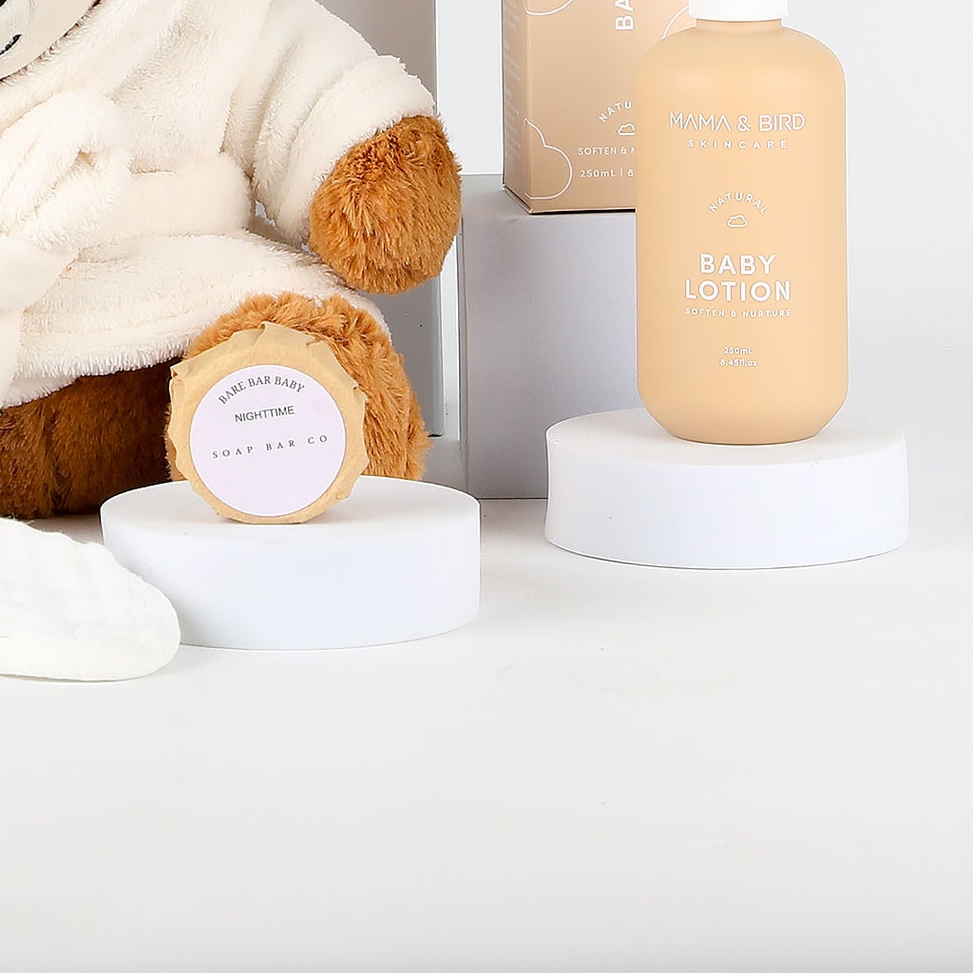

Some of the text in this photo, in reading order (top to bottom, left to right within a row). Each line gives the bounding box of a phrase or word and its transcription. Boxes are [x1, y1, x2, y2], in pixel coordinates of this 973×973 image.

[598, 100, 633, 123] NATU
[669, 112, 806, 132] MAMA & BIRD
[578, 146, 617, 156] SOFTEN
[620, 147, 628, 155] &
[687, 139, 788, 149] SKINCARE
[580, 169, 616, 178] 250mL
[708, 192, 770, 215] NATURAL
[699, 253, 777, 276] BABY
[685, 279, 792, 302] LOTION
[684, 307, 726, 318] SOFTEN
[742, 309, 792, 318] NURTURE
[723, 346, 754, 355] 250mL
[218, 375, 306, 405] BARE BAR BABY
[234, 405, 295, 423] NIGHTTIME
[212, 434, 328, 459] SOAP BAR CO
